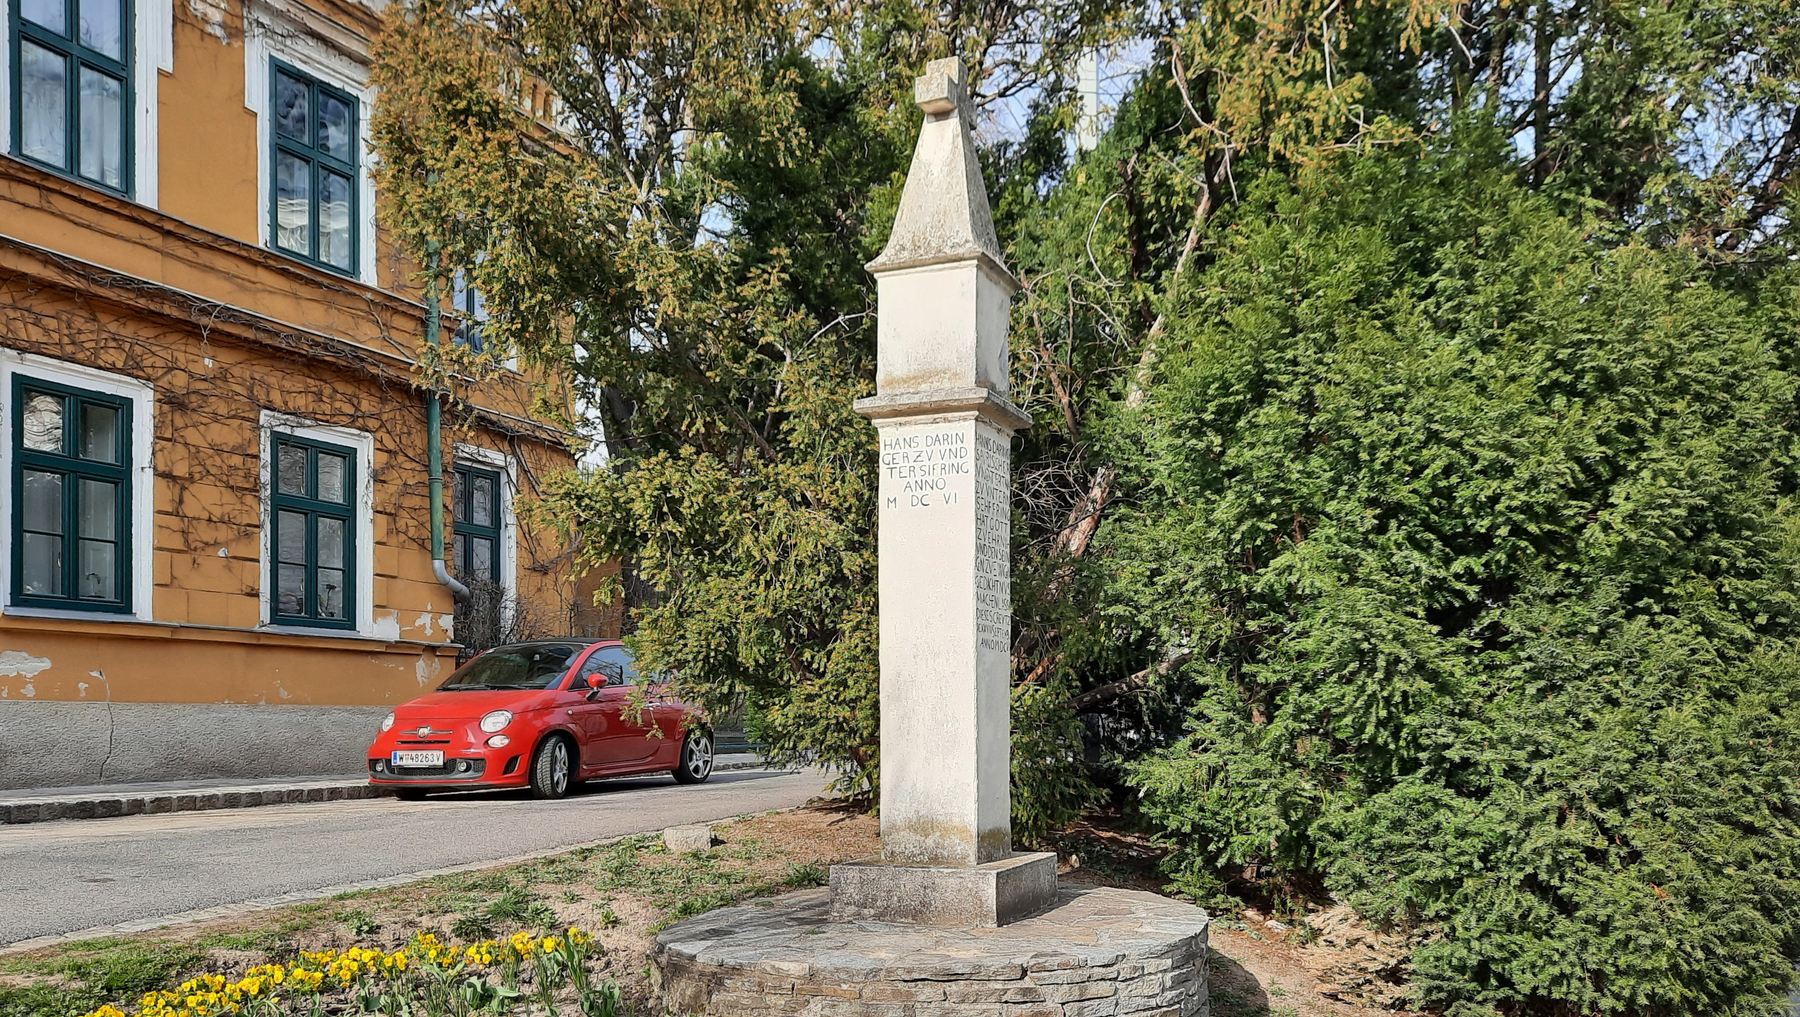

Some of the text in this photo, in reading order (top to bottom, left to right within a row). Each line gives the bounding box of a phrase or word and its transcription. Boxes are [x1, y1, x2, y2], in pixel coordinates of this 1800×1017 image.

[883, 432, 965, 451] HANS DARIN
[939, 446, 968, 461] VND
[903, 477, 947, 493] ANNO
[886, 491, 957, 509] M DC VI
[989, 517, 1008, 533] GOTT
[398, 753, 405, 763] W
